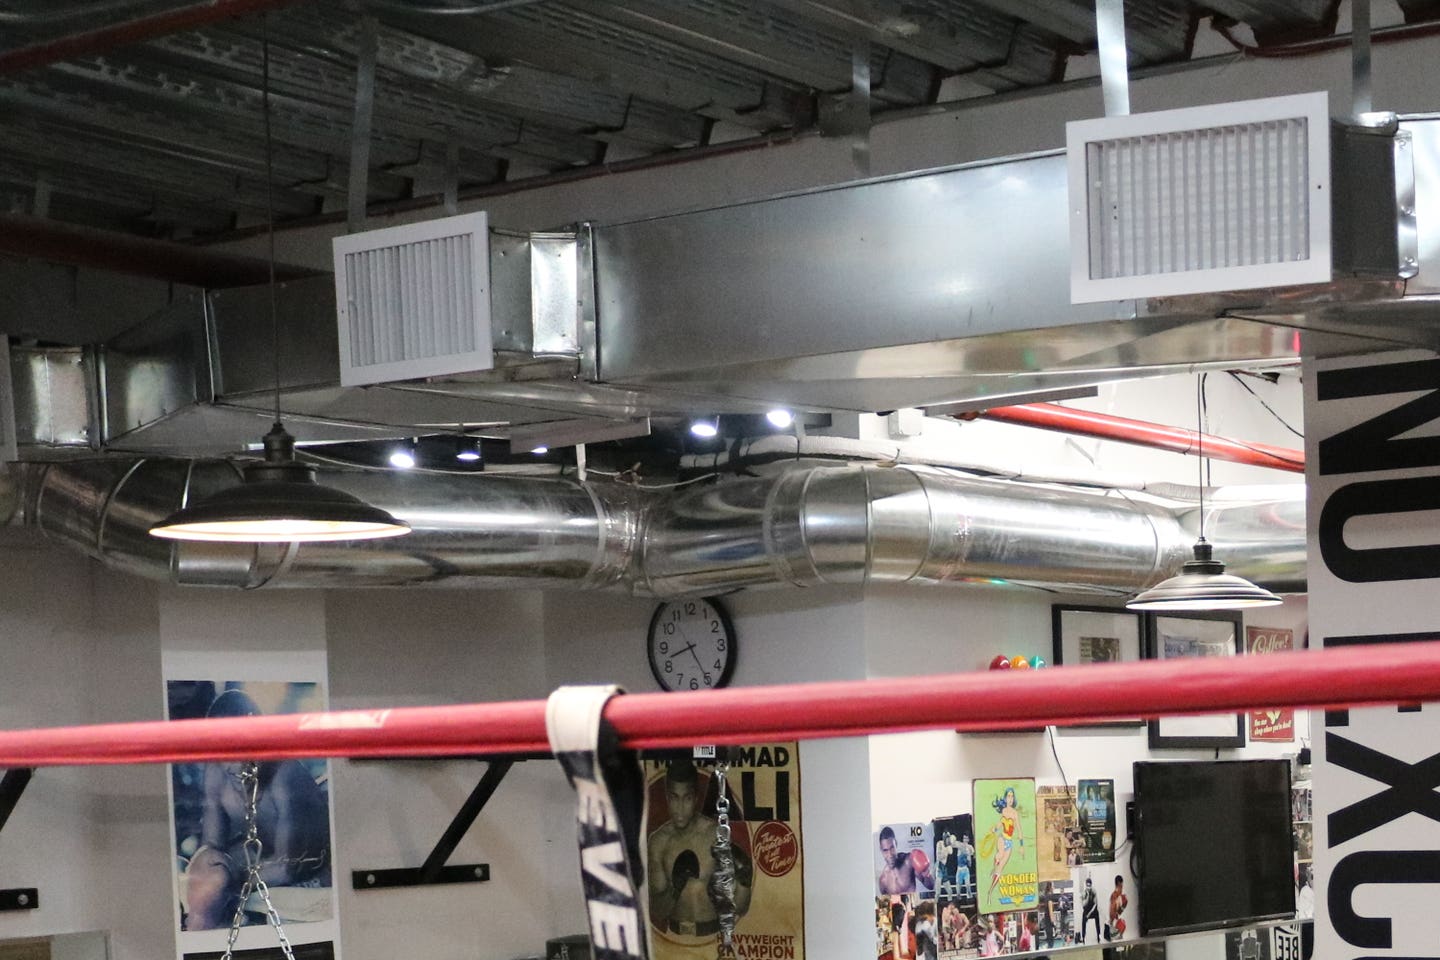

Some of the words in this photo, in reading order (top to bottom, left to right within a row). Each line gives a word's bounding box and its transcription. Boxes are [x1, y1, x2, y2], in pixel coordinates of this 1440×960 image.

[684, 602, 696, 615] 12
[703, 608, 708, 620] 1
[672, 610, 681, 621] 11
[663, 622, 675, 635] 10
[711, 620, 719, 633] 2
[660, 641, 668, 654] 9
[717, 639, 726, 652] 3
[664, 660, 673, 673] 8
[713, 659, 721, 670] 4
[676, 673, 684, 685] 7
[690, 678, 699, 690] 6
[910, 826, 923, 837] KO
[999, 872, 1037, 885] WONDER
[1000, 885, 1036, 898] WOMAN
[716, 934, 794, 946] HAVYWEIGHT
